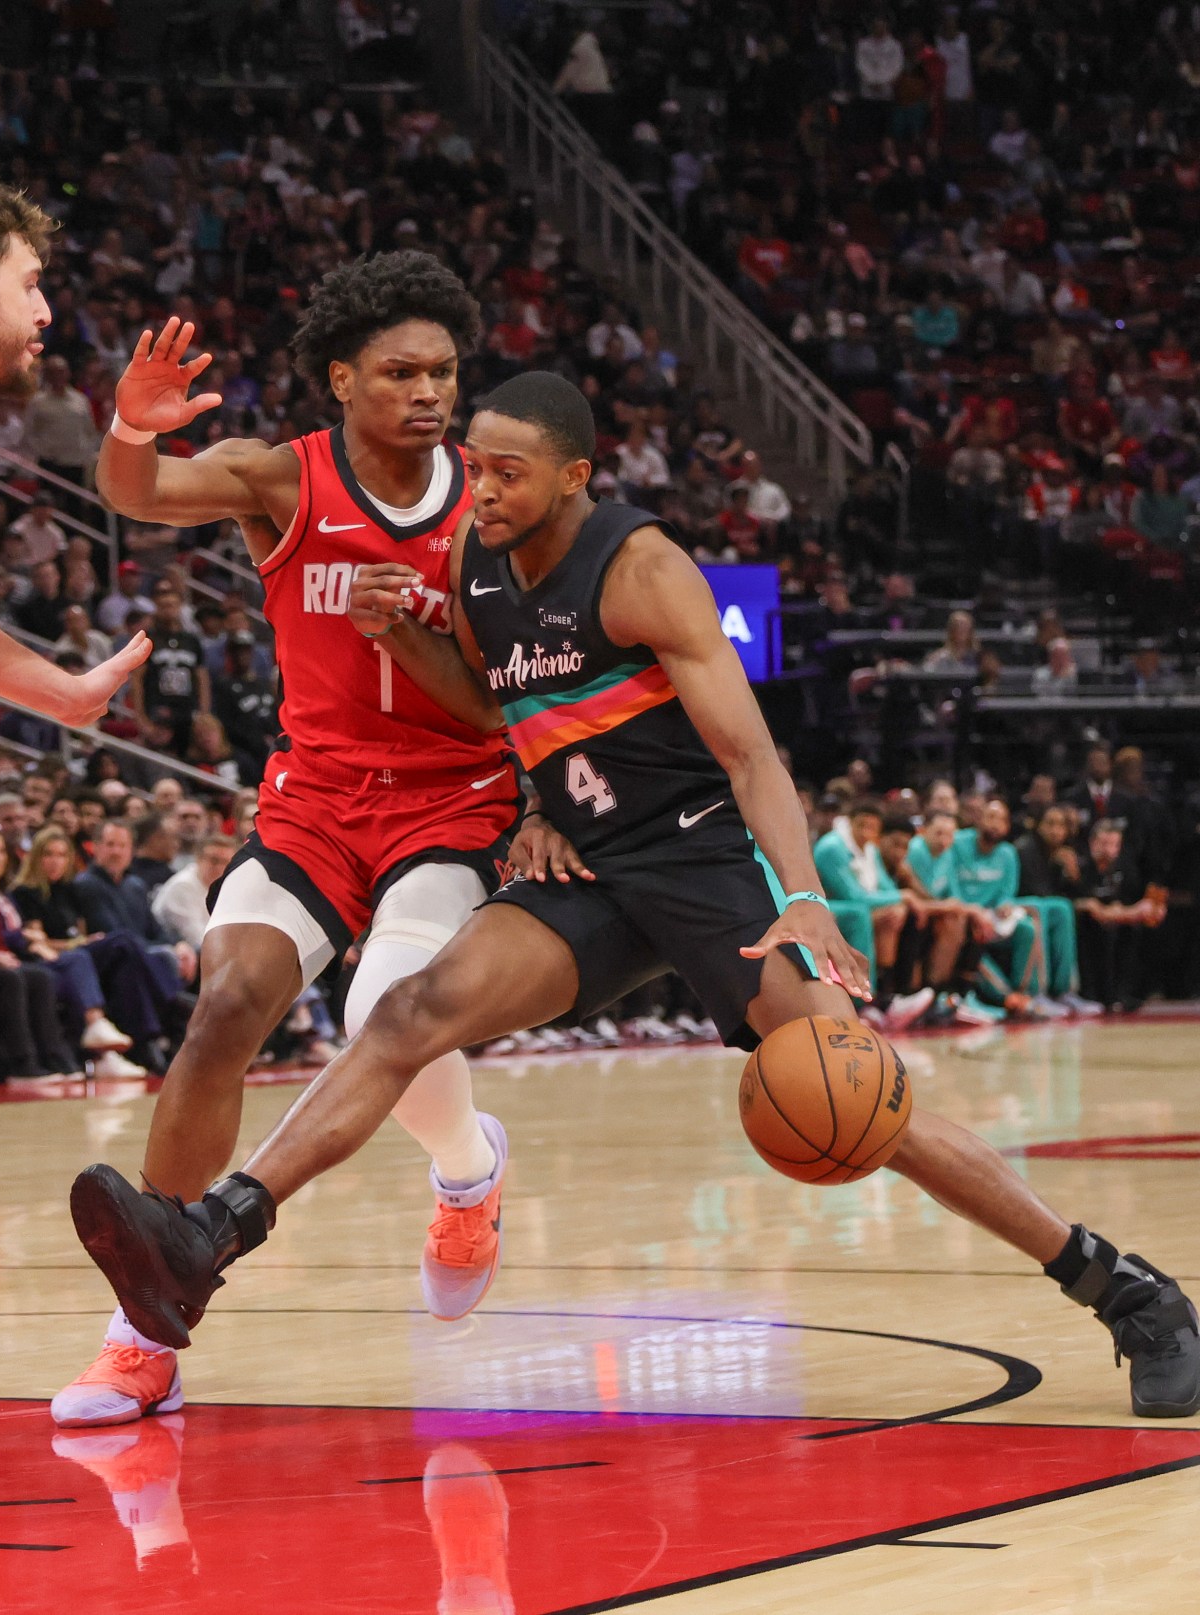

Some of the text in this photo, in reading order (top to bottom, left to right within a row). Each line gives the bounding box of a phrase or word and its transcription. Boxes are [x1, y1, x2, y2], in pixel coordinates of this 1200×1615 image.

[543, 613, 572, 626] LEDGER
[374, 641, 392, 713] 1
[503, 641, 585, 690] Antonio
[565, 752, 617, 817] 4
